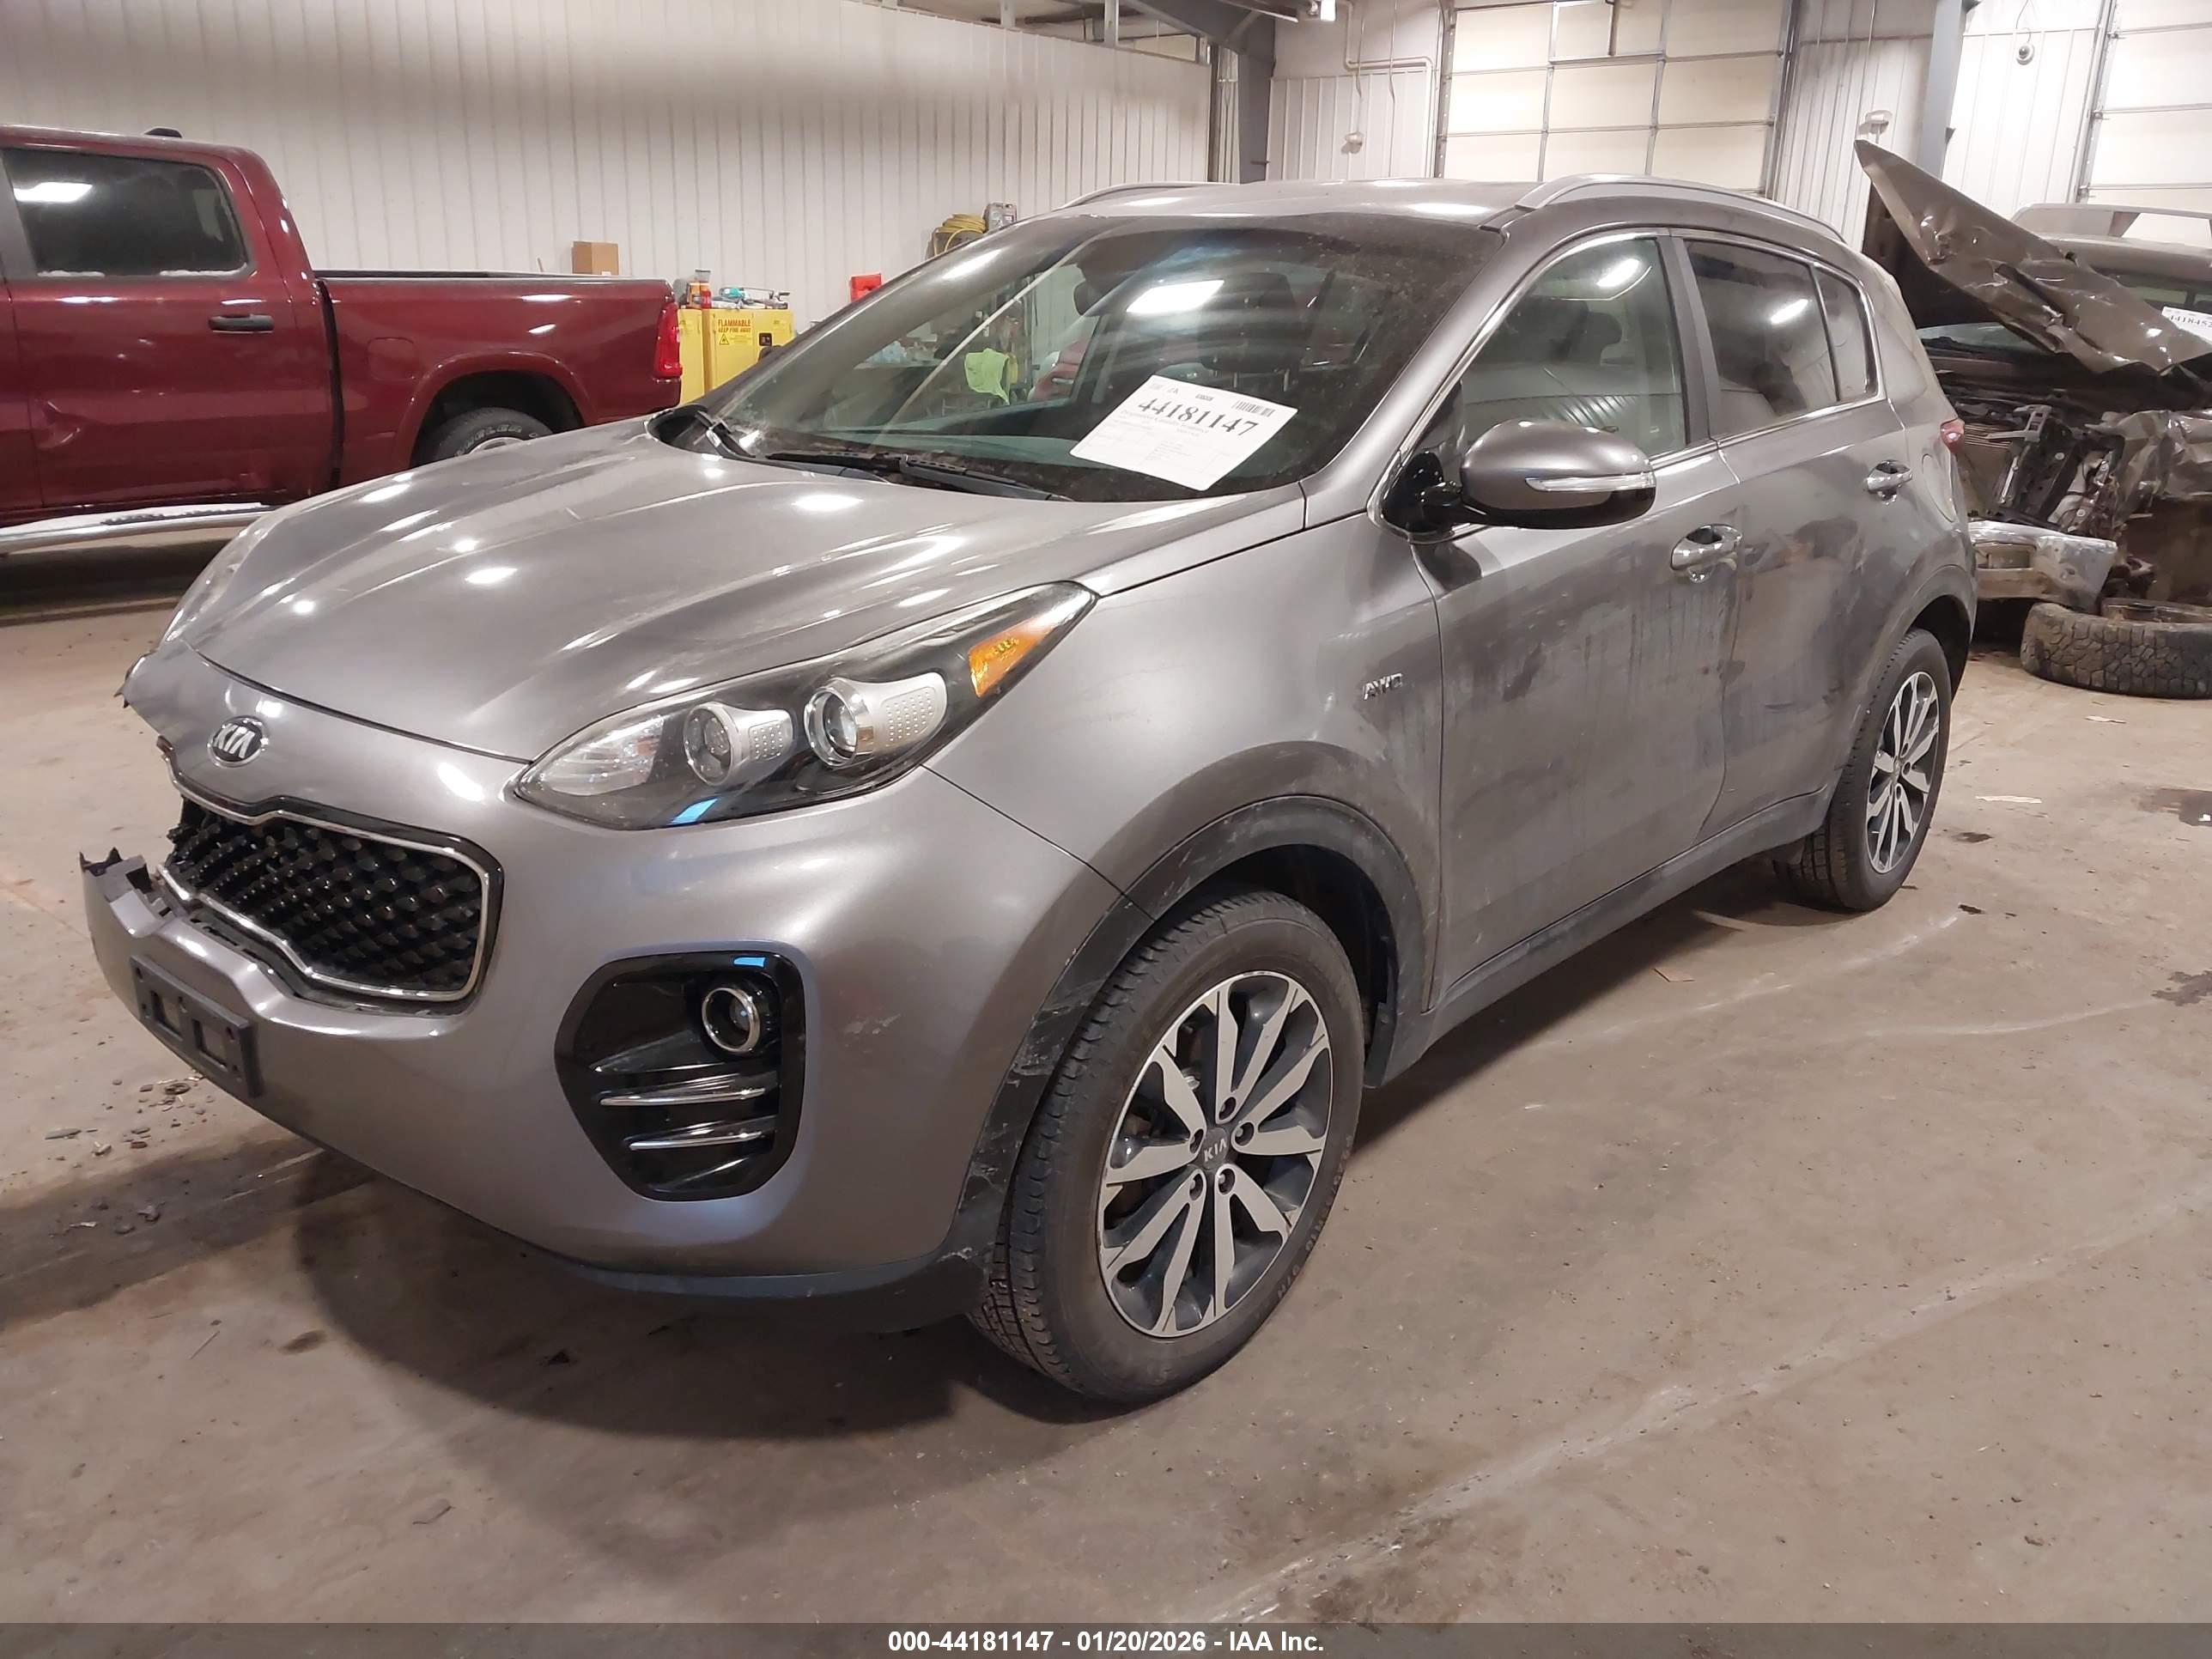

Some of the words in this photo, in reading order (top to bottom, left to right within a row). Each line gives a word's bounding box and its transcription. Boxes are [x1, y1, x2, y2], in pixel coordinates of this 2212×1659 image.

[718, 319, 751, 327] FLAMMABLE
[1138, 398, 1259, 436] 44181147
[213, 722, 255, 759] KIA
[1203, 1138, 1227, 1163] KIA
